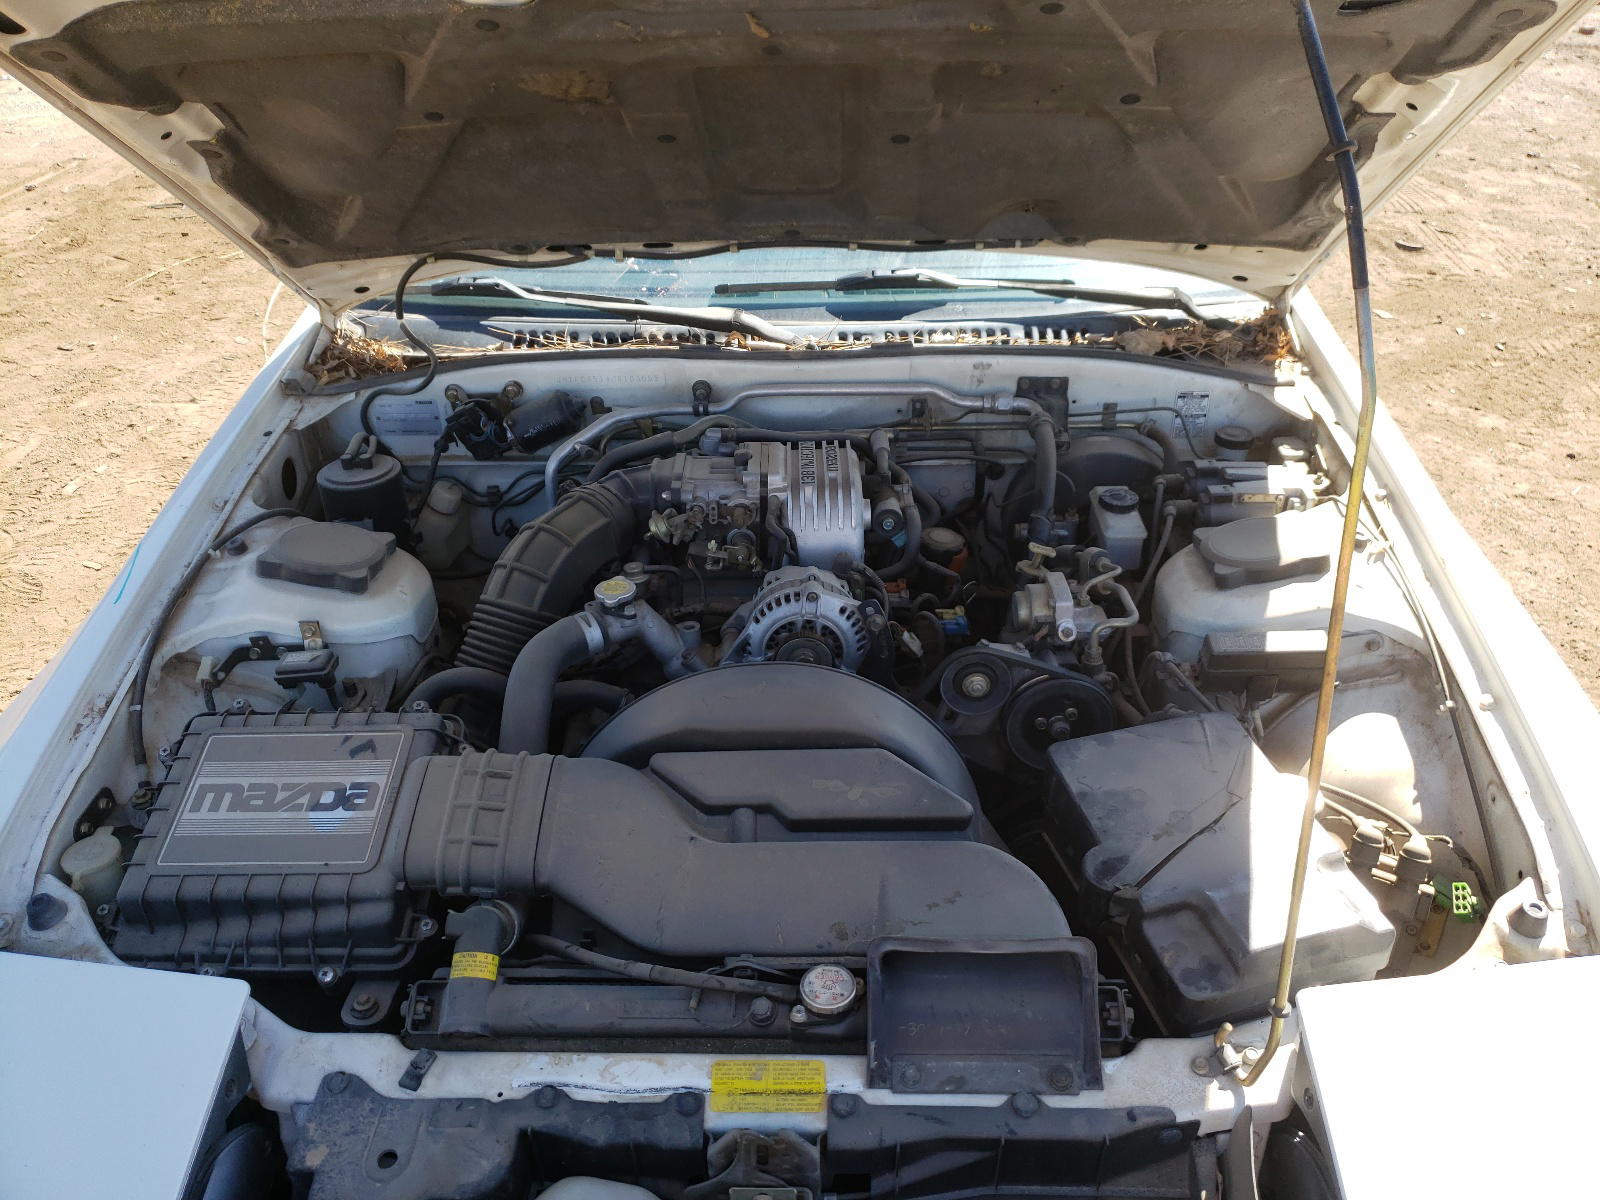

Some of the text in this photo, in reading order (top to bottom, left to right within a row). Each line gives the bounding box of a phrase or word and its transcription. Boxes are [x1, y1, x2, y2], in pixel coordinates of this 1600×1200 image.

[800, 441, 816, 485] 13B INJECTI
[188, 781, 381, 813] mazda
